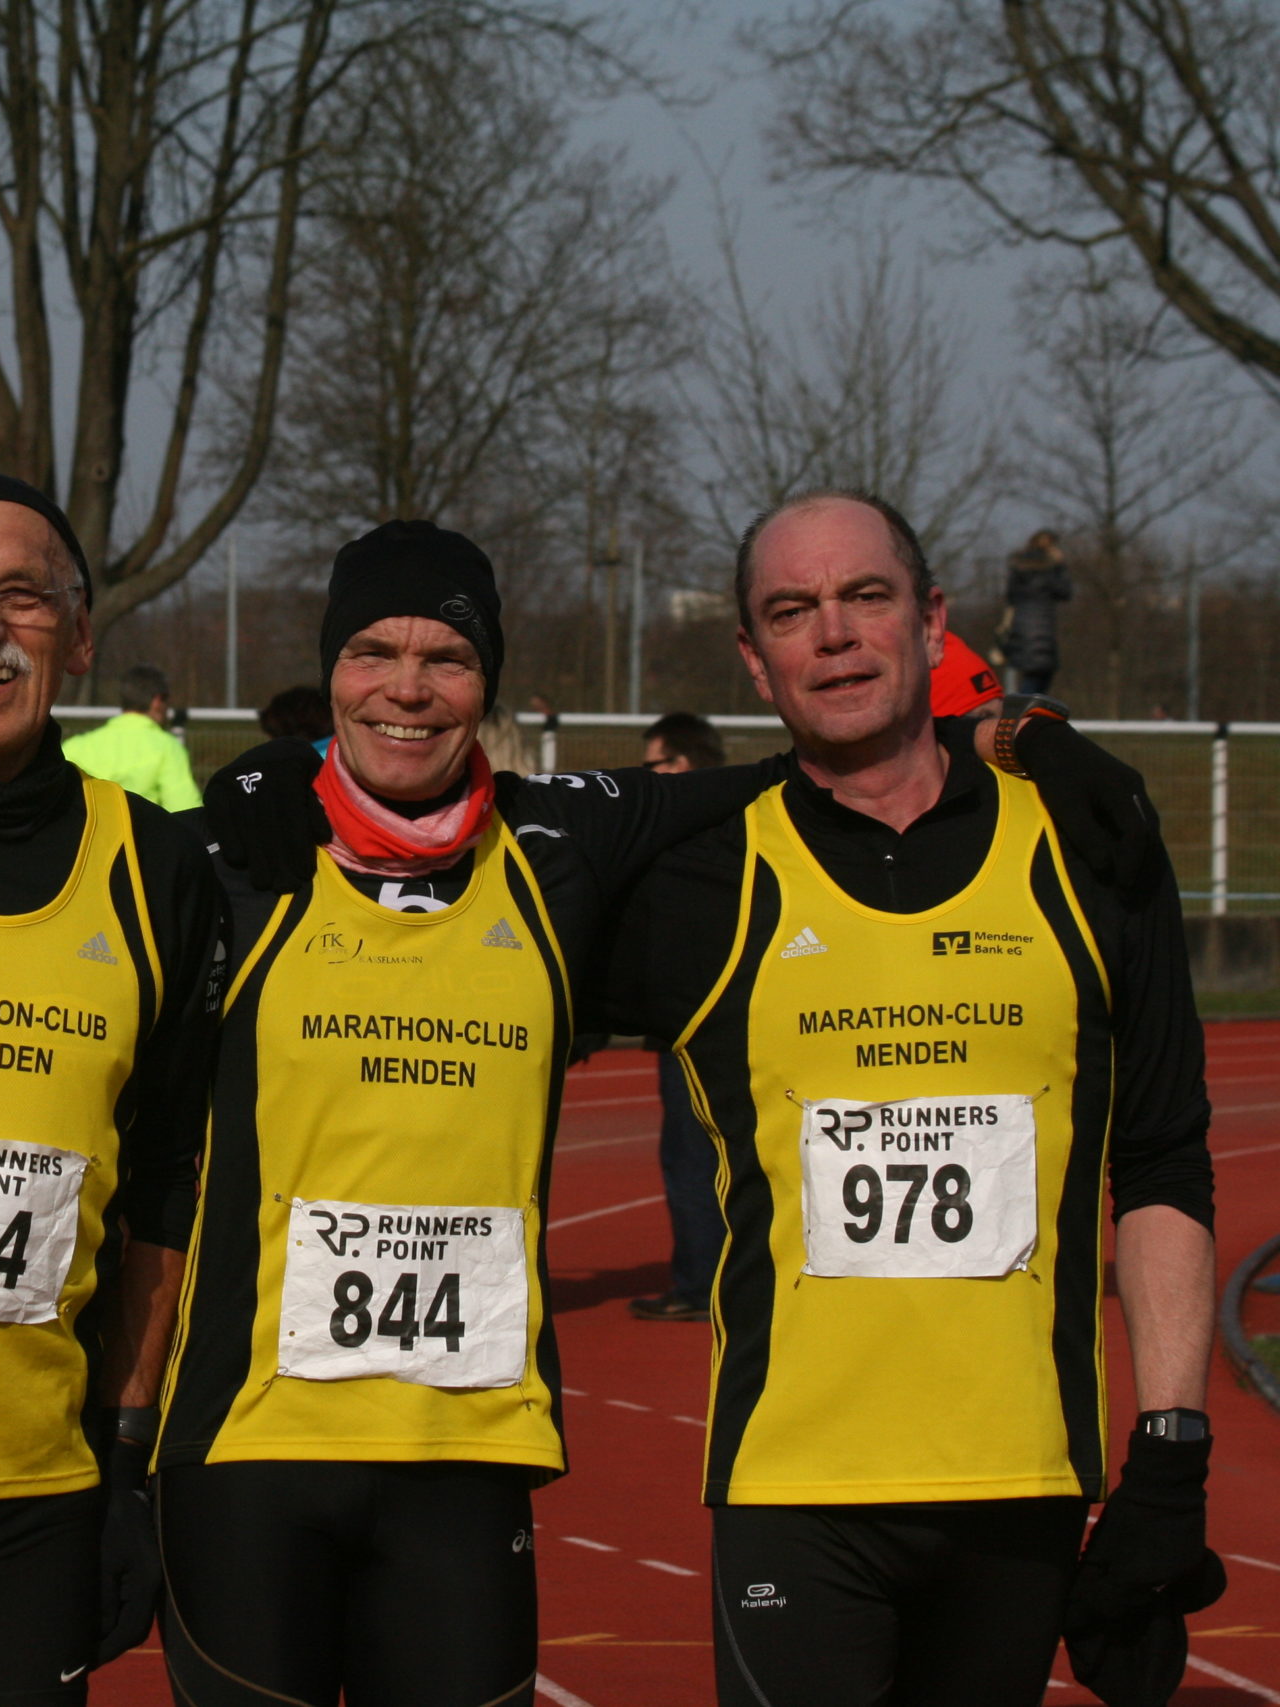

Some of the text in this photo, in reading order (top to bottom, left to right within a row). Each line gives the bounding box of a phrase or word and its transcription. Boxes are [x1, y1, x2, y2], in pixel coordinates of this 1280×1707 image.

[319, 933, 345, 948] TK
[481, 936, 524, 951] adidas
[974, 931, 1035, 944] Mendener
[76, 948, 119, 966] adidas
[779, 942, 829, 959] adidas
[974, 944, 1023, 956] Bank eG
[798, 1002, 1024, 1035] MARATHON-CLUB
[301, 1013, 529, 1051] MARATHON-CLUB
[856, 1040, 968, 1067] MENDEN
[360, 1056, 476, 1088] MENDEN
[880, 1105, 999, 1127] RUNNERS
[880, 1131, 955, 1152] POINT
[842, 1163, 974, 1244] 978
[377, 1214, 493, 1237] RUNNERS
[376, 1239, 449, 1261] POINT
[329, 1269, 466, 1353] 844
[740, 1596, 786, 1608] Kalenji
